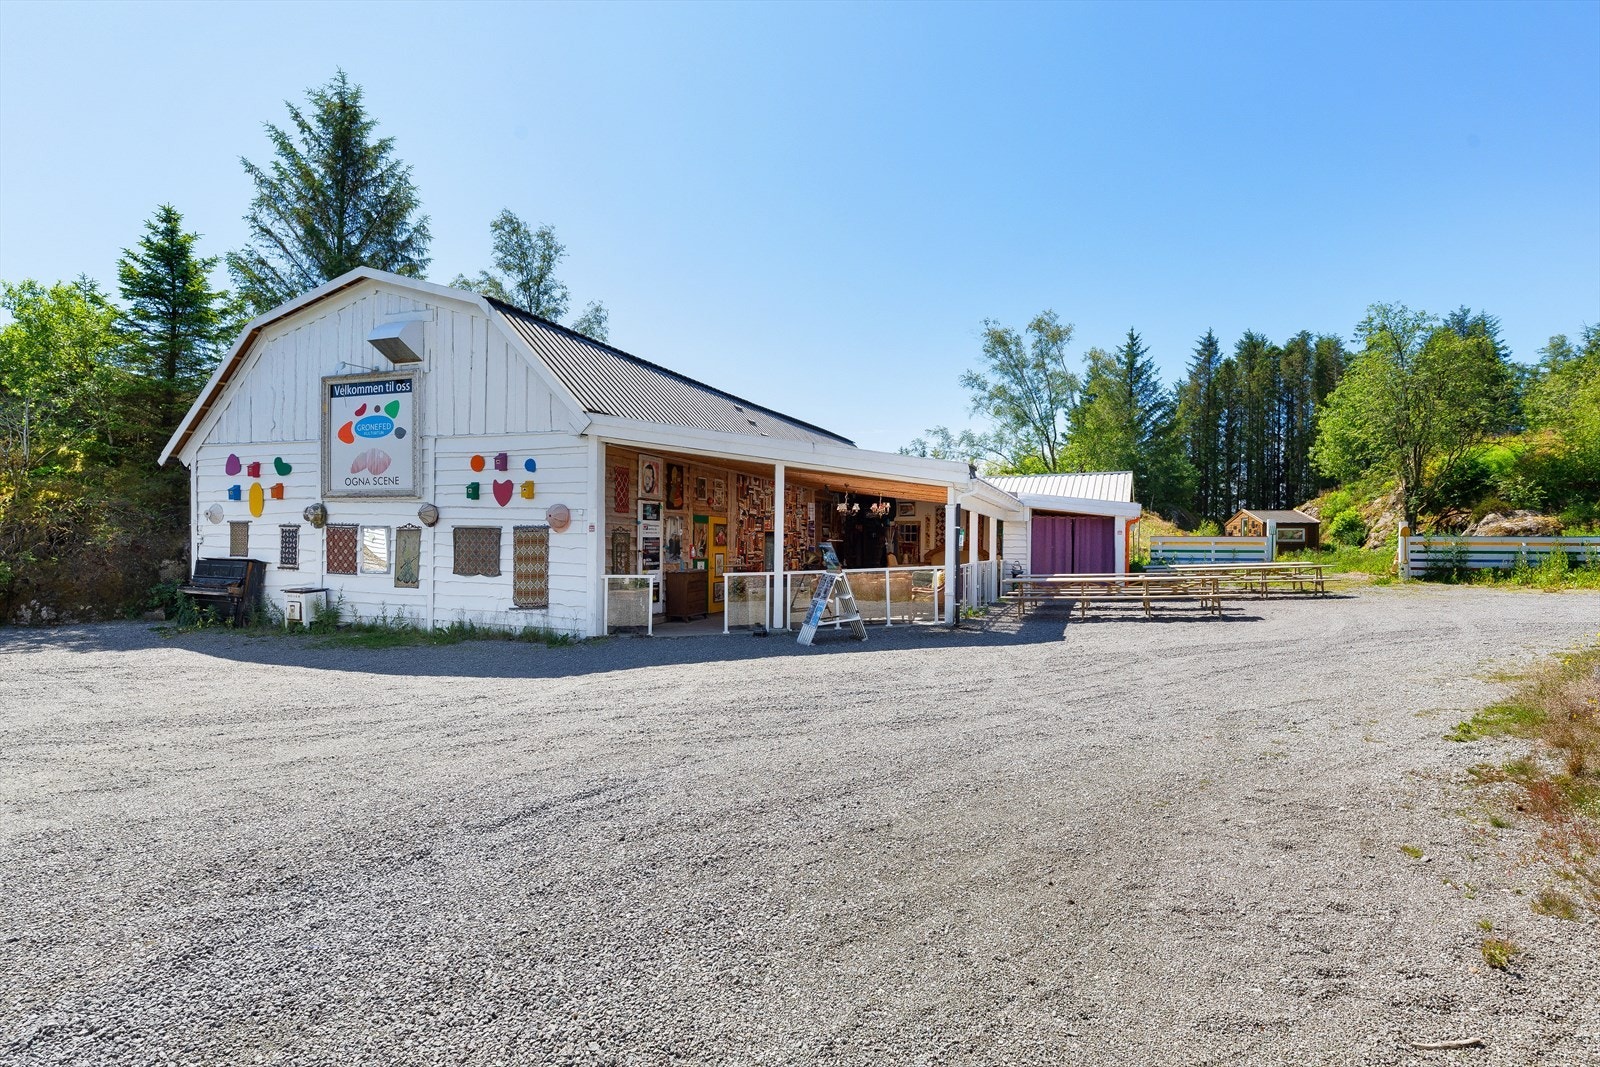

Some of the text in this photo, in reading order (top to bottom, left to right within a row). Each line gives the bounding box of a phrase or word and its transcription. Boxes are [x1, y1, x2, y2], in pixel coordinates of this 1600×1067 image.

[334, 381, 410, 395] Velkommen til oss
[345, 477, 400, 486] OGNA SCENE
